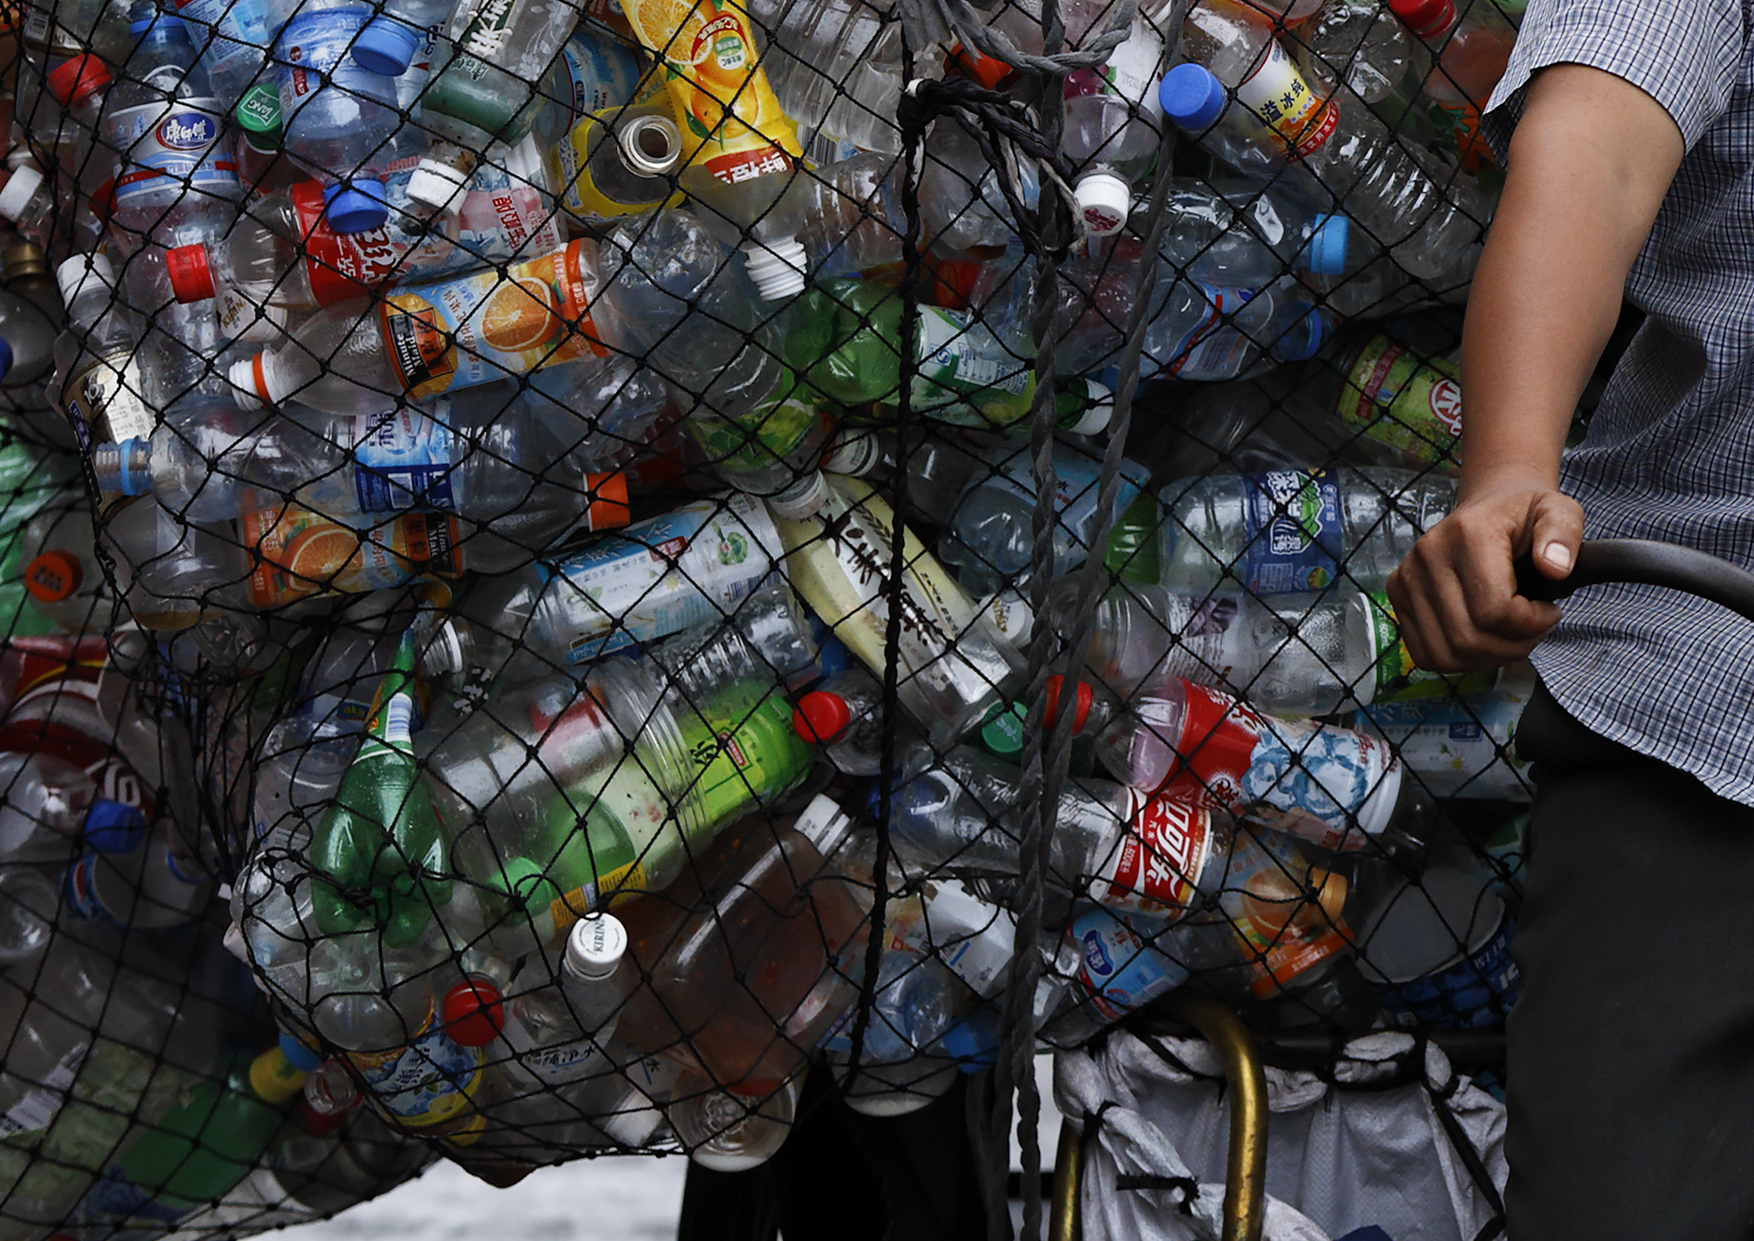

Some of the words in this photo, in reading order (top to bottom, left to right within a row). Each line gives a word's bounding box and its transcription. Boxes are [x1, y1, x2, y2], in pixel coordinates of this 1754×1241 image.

[247, 99, 274, 121] TANG
[221, 298, 246, 329] KIRIN
[397, 330, 417, 378] Minute
[404, 335, 422, 372] Maid
[592, 918, 607, 954] KIRIN
